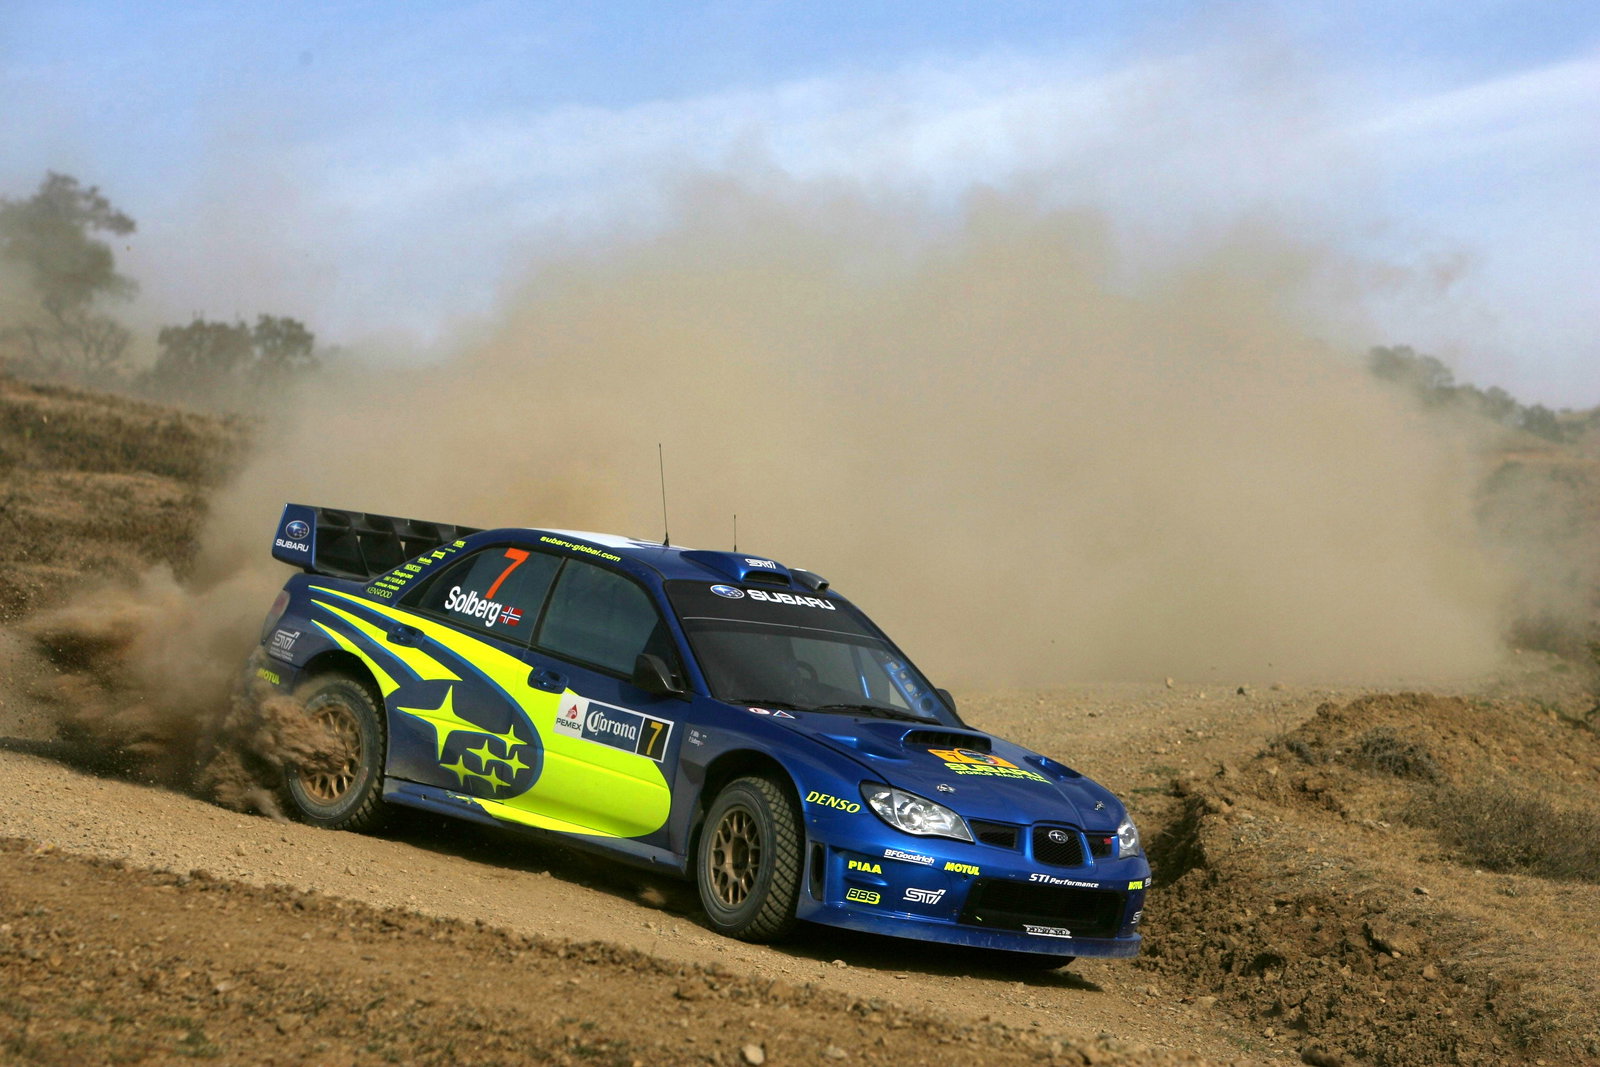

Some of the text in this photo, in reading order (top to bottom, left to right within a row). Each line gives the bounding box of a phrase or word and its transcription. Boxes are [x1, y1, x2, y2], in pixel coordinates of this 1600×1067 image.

[275, 538, 309, 552] SUBARU
[484, 547, 530, 599] 7
[366, 586, 392, 599] KENWOOD
[746, 589, 836, 611] SUBARU
[444, 585, 502, 627] Solberg
[556, 717, 582, 731] PEMEX
[586, 710, 637, 741] Corona
[646, 721, 664, 756] 7
[944, 762, 1046, 780] SUBARU
[805, 791, 861, 814] DENSO
[884, 849, 935, 864] BFGoodrich
[848, 860, 882, 874] PIAA
[944, 861, 980, 876] MOTUL
[1029, 873, 1100, 889] STI Performance
[848, 888, 878, 902] BBS
